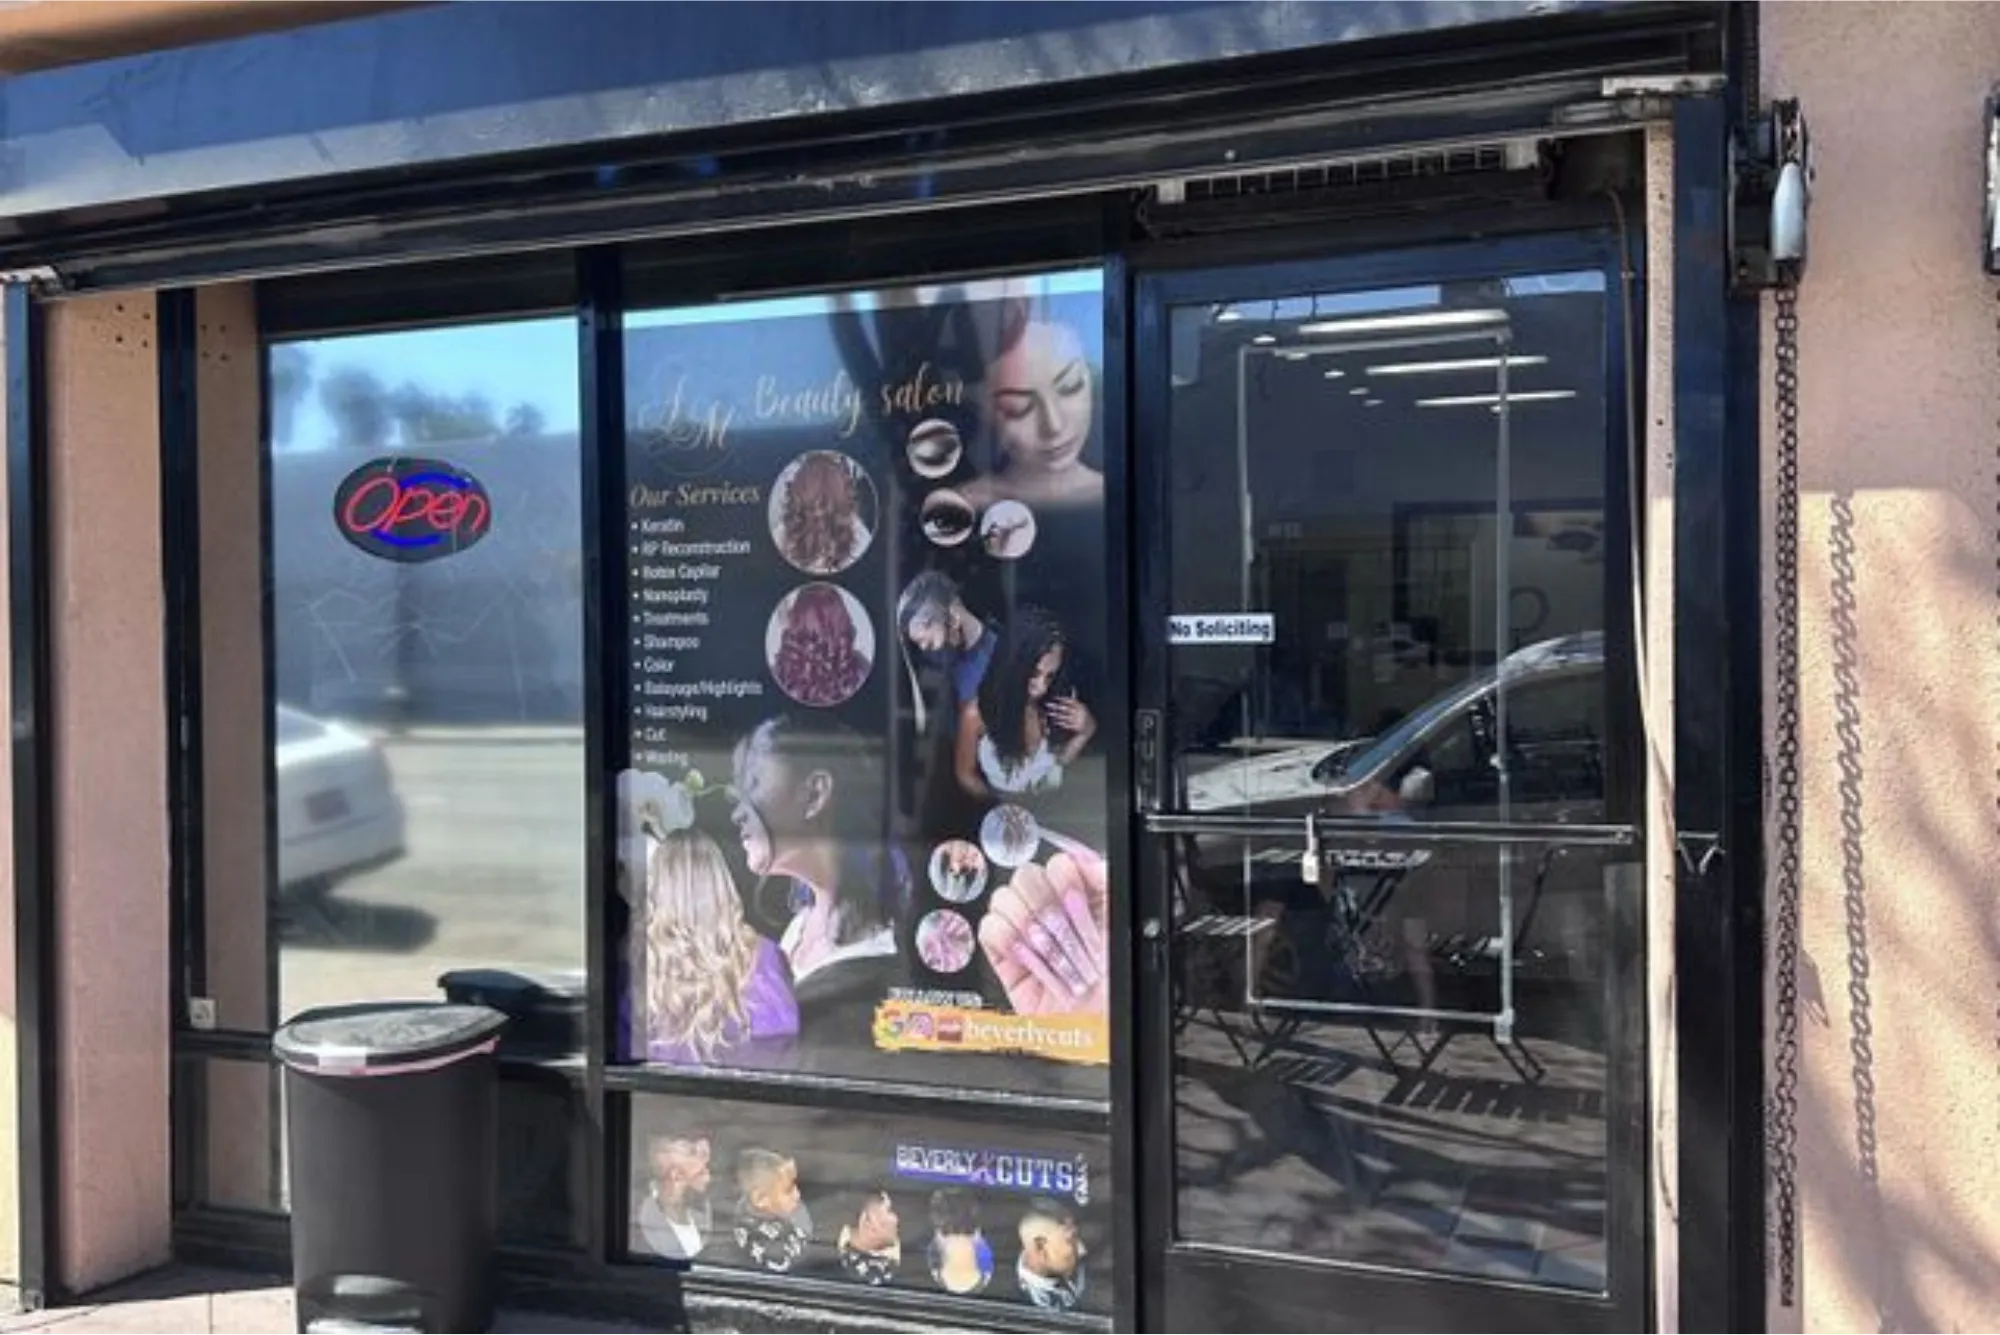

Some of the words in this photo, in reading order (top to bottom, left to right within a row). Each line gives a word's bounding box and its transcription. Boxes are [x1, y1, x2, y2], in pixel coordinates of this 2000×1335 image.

[755, 368, 862, 438] Beauty
[880, 362, 964, 416] salon
[630, 484, 670, 508] Our
[675, 480, 761, 506] Services
[344, 476, 487, 533] Open
[641, 518, 686, 533] Keratin
[662, 538, 752, 555] Reconstruction
[643, 611, 710, 626] Treatments
[1170, 620, 1192, 637] No
[1196, 617, 1271, 638] Soliciting
[643, 633, 700, 650] Shampoo
[643, 656, 675, 673] Color
[643, 679, 764, 698] Balayage/Highlights
[643, 727, 667, 742] Cut
[964, 1015, 1093, 1048] beverlycuts
[896, 1144, 978, 1175] BEVERLY
[997, 1154, 1073, 1192] CUTS
